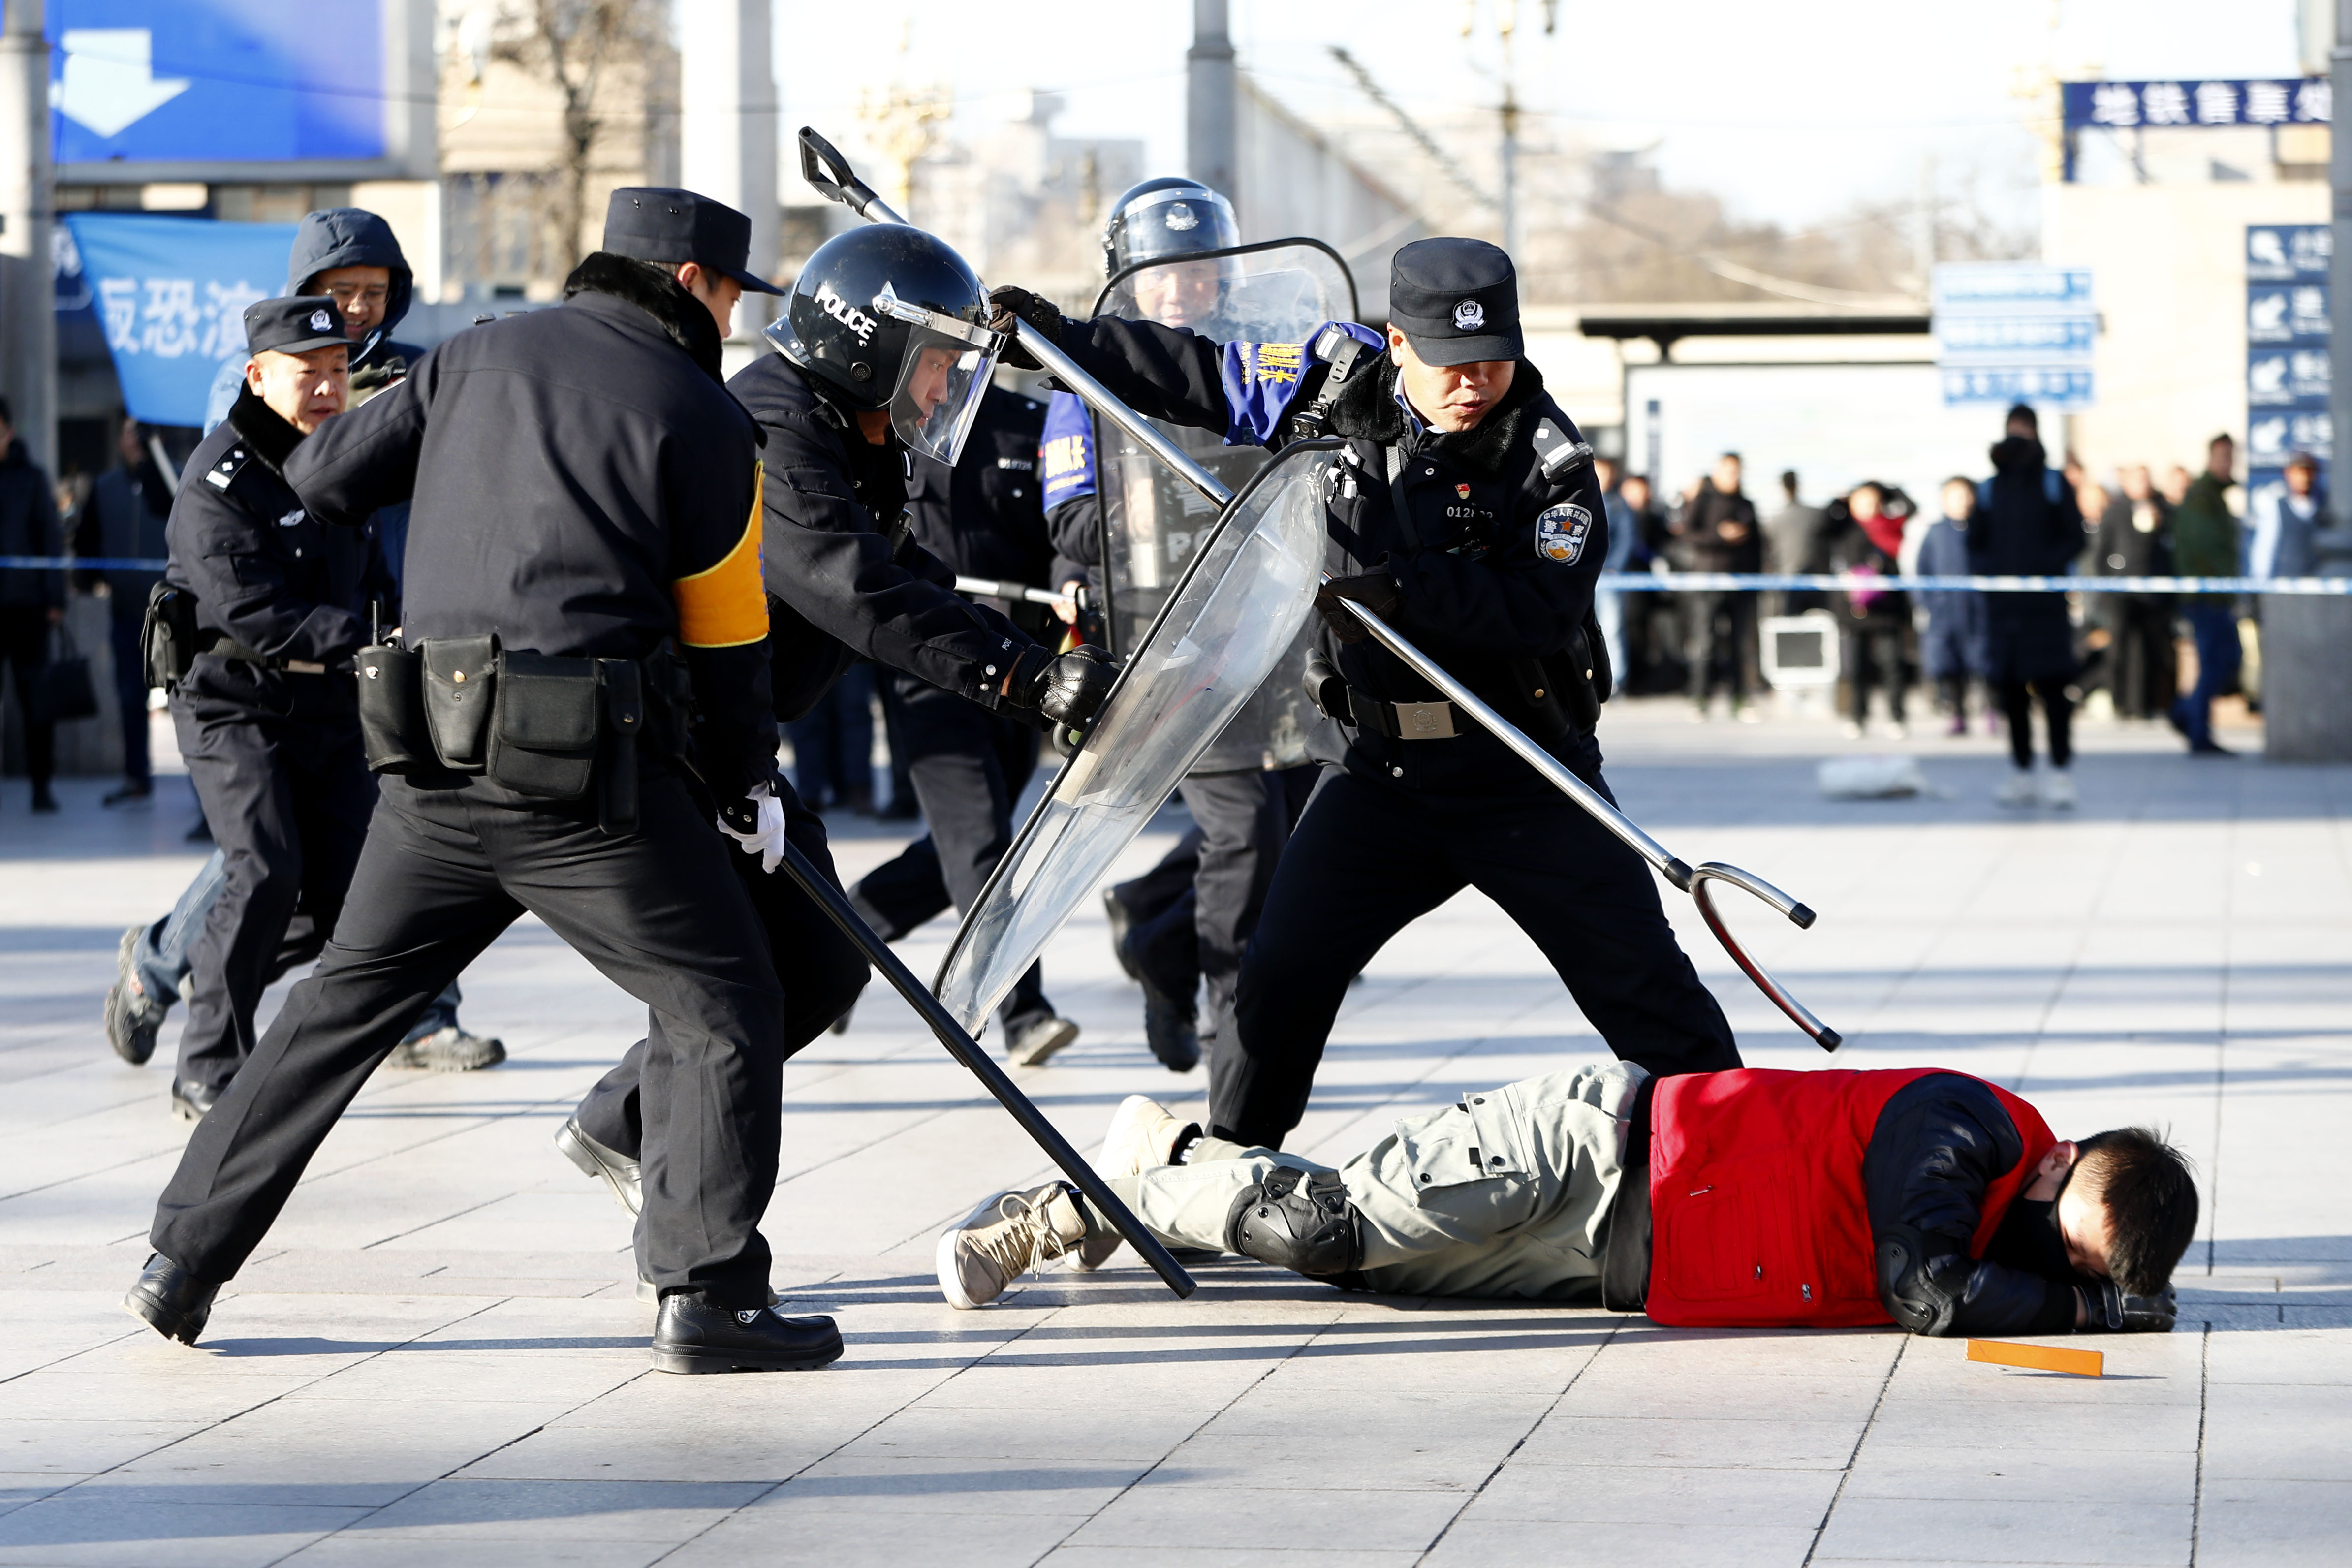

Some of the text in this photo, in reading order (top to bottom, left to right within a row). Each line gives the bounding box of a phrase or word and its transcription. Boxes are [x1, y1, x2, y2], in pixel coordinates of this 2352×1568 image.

[100, 277, 289, 361] 反恐演
[814, 285, 878, 340] POLICE
[1543, 508, 1589, 525] 中华人民共和国
